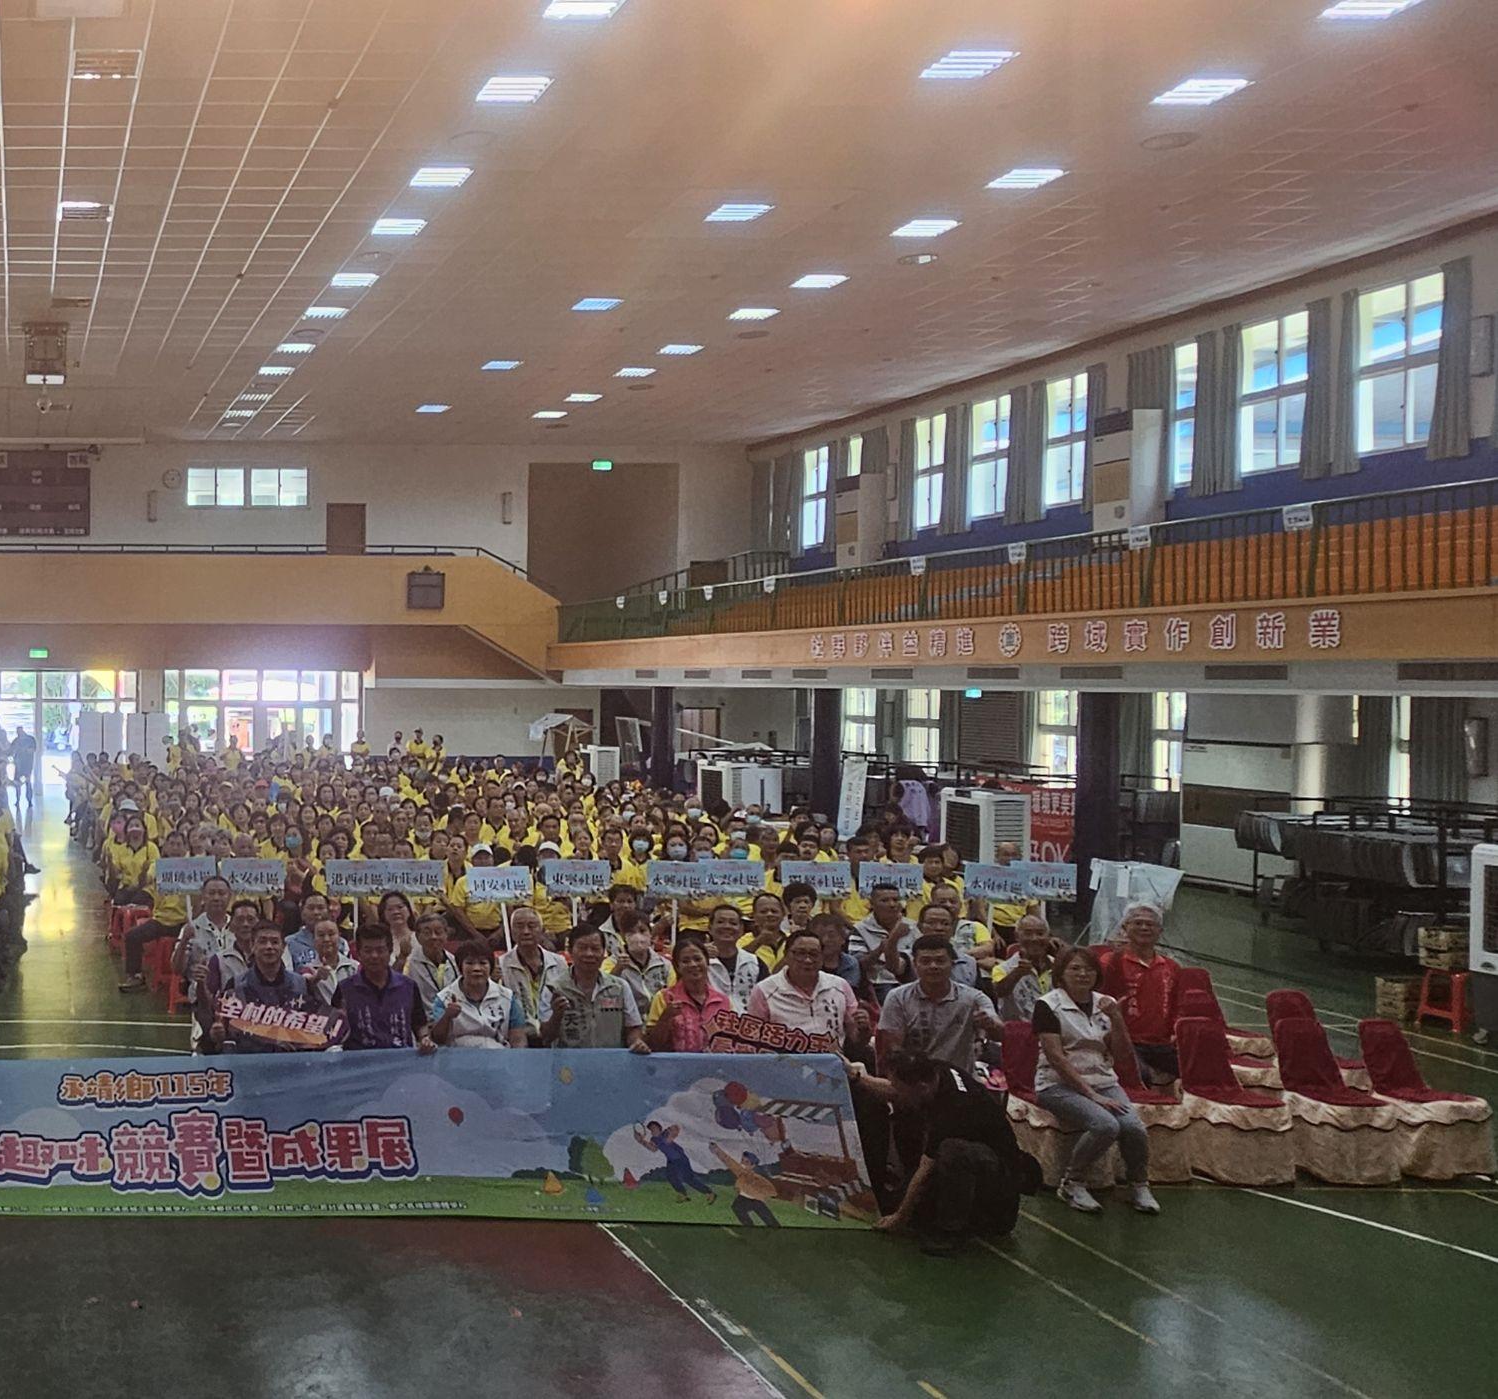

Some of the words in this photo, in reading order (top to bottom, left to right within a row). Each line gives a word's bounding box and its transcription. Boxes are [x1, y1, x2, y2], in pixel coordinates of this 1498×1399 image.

[1047, 609, 1342, 655] 跨域實作創新業
[217, 996, 344, 1039] 全村的希望！
[60, 1070, 234, 1105] 永靖鄉115年
